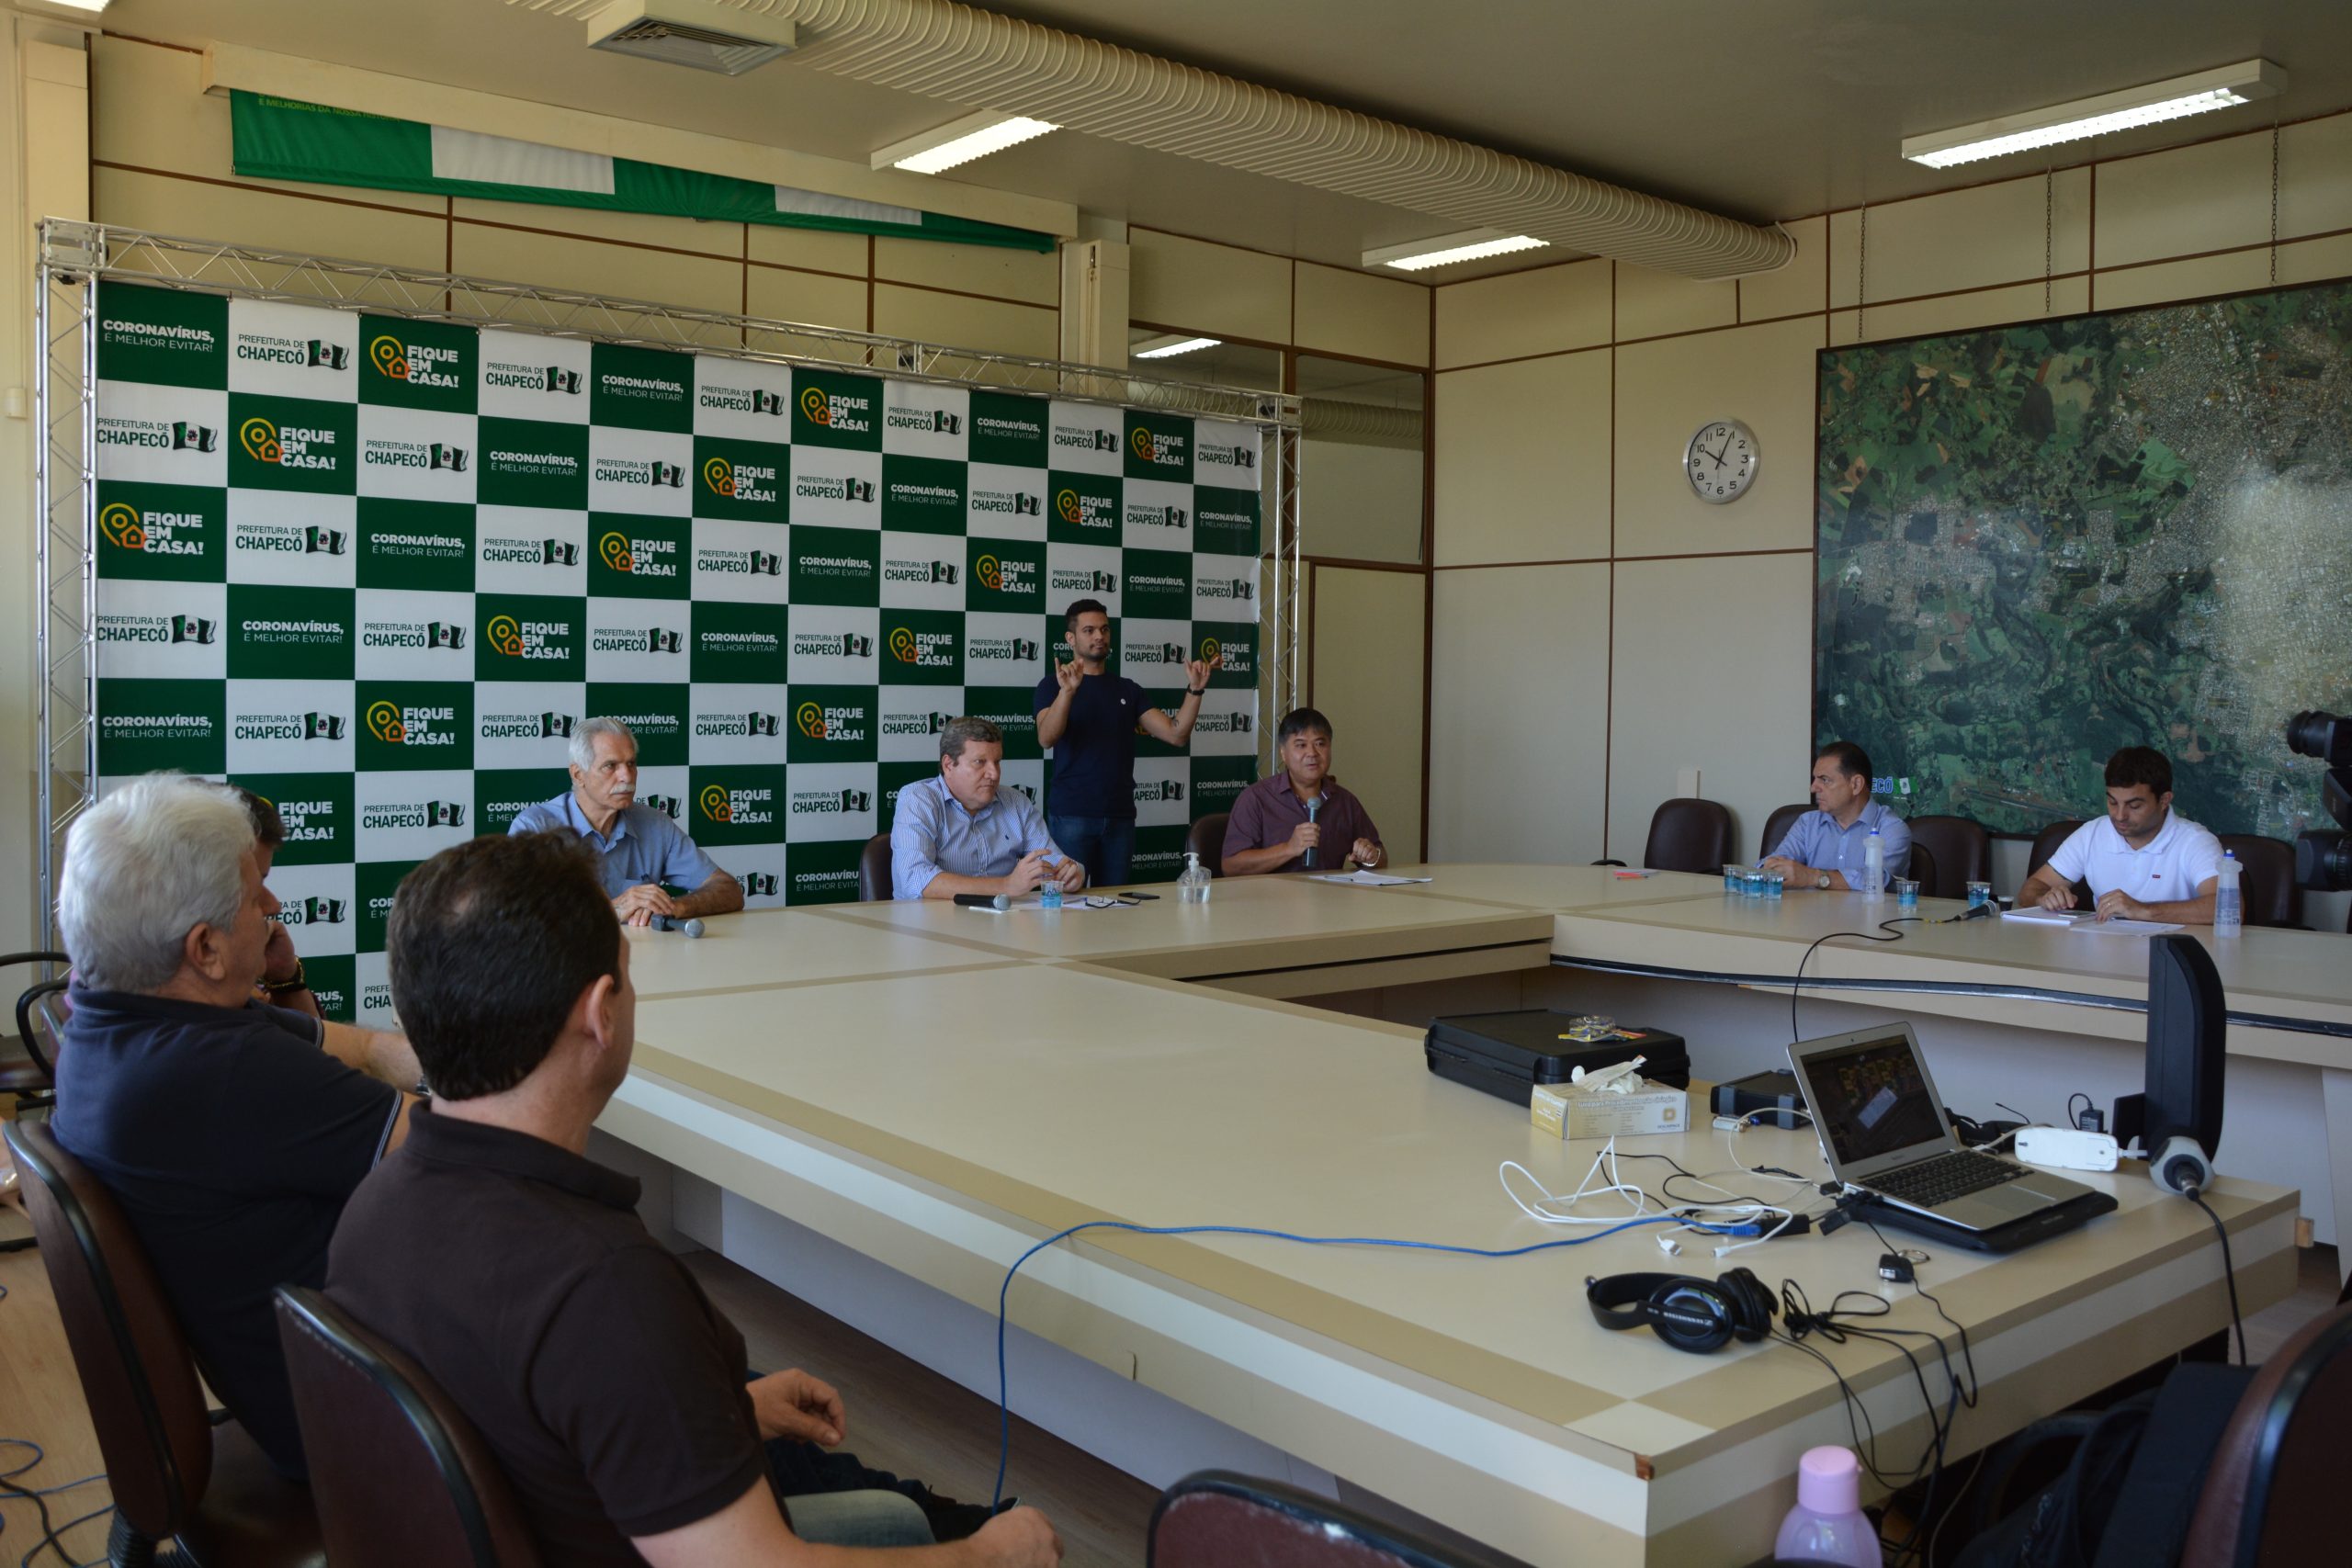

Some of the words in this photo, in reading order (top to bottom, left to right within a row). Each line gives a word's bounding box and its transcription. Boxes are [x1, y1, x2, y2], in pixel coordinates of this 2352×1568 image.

[103, 320, 214, 344] CORONAVÍRUS,
[105, 331, 112, 342] É
[115, 333, 166, 348] MELHOR
[168, 339, 212, 353] EVITAR!
[238, 333, 290, 347] PREFEITURA
[292, 339, 304, 349] DE
[237, 344, 304, 365] CHAPECÓ
[407, 344, 458, 363] FIQUE
[407, 356, 432, 372] EM
[487, 361, 532, 374] PREFEITURA
[533, 367, 544, 375] DE
[407, 369, 458, 388] CASA!
[485, 371, 544, 390] CHAPECÓ
[610, 387, 648, 399] MELHOR
[701, 385, 741, 396] PREFEITURA
[829, 394, 868, 410] FIQUE
[97, 417, 154, 430] PREFEITURA
[156, 422, 169, 432] DE
[829, 416, 868, 432] CASA!
[97, 429, 169, 448] CHAPECÓ
[279, 426, 335, 444] FIQUE
[1706, 433, 1713, 441] 11
[1716, 427, 1725, 436] 12
[279, 439, 307, 455] EM
[366, 439, 414, 451] PREFEITURA
[416, 444, 427, 452] DE
[1697, 444, 1705, 453] 10
[1738, 440, 1746, 449] 2
[279, 452, 335, 470] CASA!
[365, 450, 427, 468] CHAPECÓ
[596, 457, 639, 468] PREFEITURA
[639, 461, 650, 469] DE
[1693, 458, 1701, 467] 9
[1741, 455, 1749, 464] 3
[499, 462, 539, 474] MELHOR
[733, 464, 775, 479] FIQUE
[1738, 468, 1745, 477] 4
[595, 468, 650, 484] CHAPECÓ
[733, 476, 753, 489] EM
[1697, 472, 1705, 480] 8
[1705, 482, 1713, 491] 7
[1716, 486, 1724, 495] 6
[1729, 480, 1737, 490] 5
[733, 487, 775, 502] CASA!
[143, 511, 203, 528] FIQUE
[143, 525, 172, 540] EM
[237, 524, 288, 535] PREFEITURA
[290, 527, 302, 536] DE
[143, 538, 204, 555] CASA!
[235, 536, 302, 552] CHAPECÓ
[484, 537, 529, 547] PREFEITURA
[530, 540, 541, 548] DE
[631, 538, 675, 553] FIQUE
[372, 544, 379, 554] É
[381, 546, 424, 556] MELHOR
[482, 547, 541, 563] CHAPECÓ
[631, 550, 652, 563] EM
[631, 562, 676, 577] CASA!
[97, 615, 153, 625] PREFEITURA
[155, 616, 168, 626] DE
[242, 619, 344, 635] CORONAVÍRUS,
[364, 622, 413, 631] PREFEITURA
[414, 624, 425, 632] DE
[97, 626, 168, 642] CHAPECÓ
[521, 622, 569, 635] FIQUE
[594, 628, 636, 637] PREFEITURA
[243, 632, 250, 642] É
[253, 633, 300, 643] MELHOR
[301, 634, 343, 644] EVITAR!
[363, 632, 425, 648] CHAPECÓ
[521, 634, 544, 647] EM
[593, 637, 647, 651] CHAPECÓ
[915, 633, 952, 645] FIQUE
[521, 646, 570, 660] CASA!
[915, 654, 953, 666] CASA!
[235, 715, 288, 723] PREFEITURA
[402, 706, 454, 719] FIQUE
[824, 707, 864, 718] FIQUE
[102, 713, 212, 728] CORONAVÍRUS,
[402, 719, 427, 732] EM
[104, 728, 110, 738] É
[114, 728, 164, 738] MELHOR
[166, 728, 210, 738] EVITAR!
[234, 723, 301, 739] CHAPECÓ
[481, 722, 539, 738] CHAPECÓ
[824, 728, 864, 740] CASA!
[402, 731, 455, 745] CASA!
[729, 788, 771, 801] FIQUE
[278, 800, 334, 815] FIQUE
[364, 804, 412, 813] PREFEITURA
[413, 803, 424, 811] DE
[729, 800, 750, 812] EM
[362, 811, 424, 829] CHAPECÓ
[729, 810, 772, 824] CASA!
